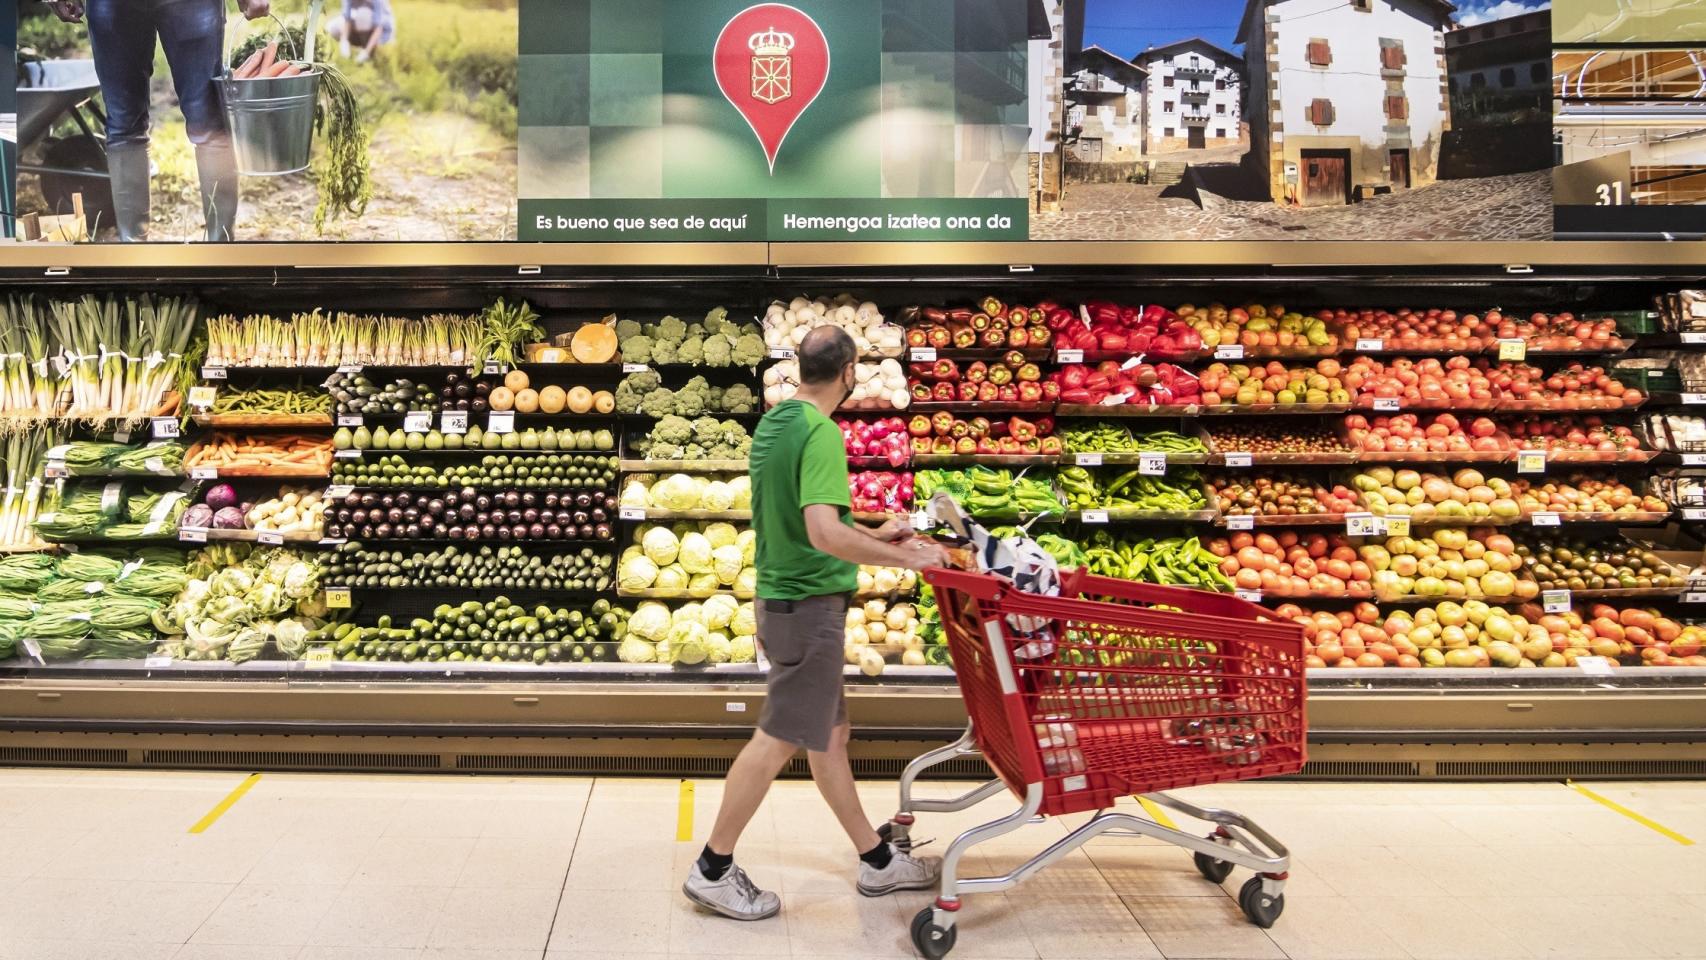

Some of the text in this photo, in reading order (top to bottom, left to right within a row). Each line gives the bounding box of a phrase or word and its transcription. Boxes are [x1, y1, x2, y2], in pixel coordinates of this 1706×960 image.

[1595, 181, 1622, 205] 31
[536, 214, 748, 232] Es bueno que sea de aquí
[783, 213, 1011, 232] Hemengoa izatea ona da
